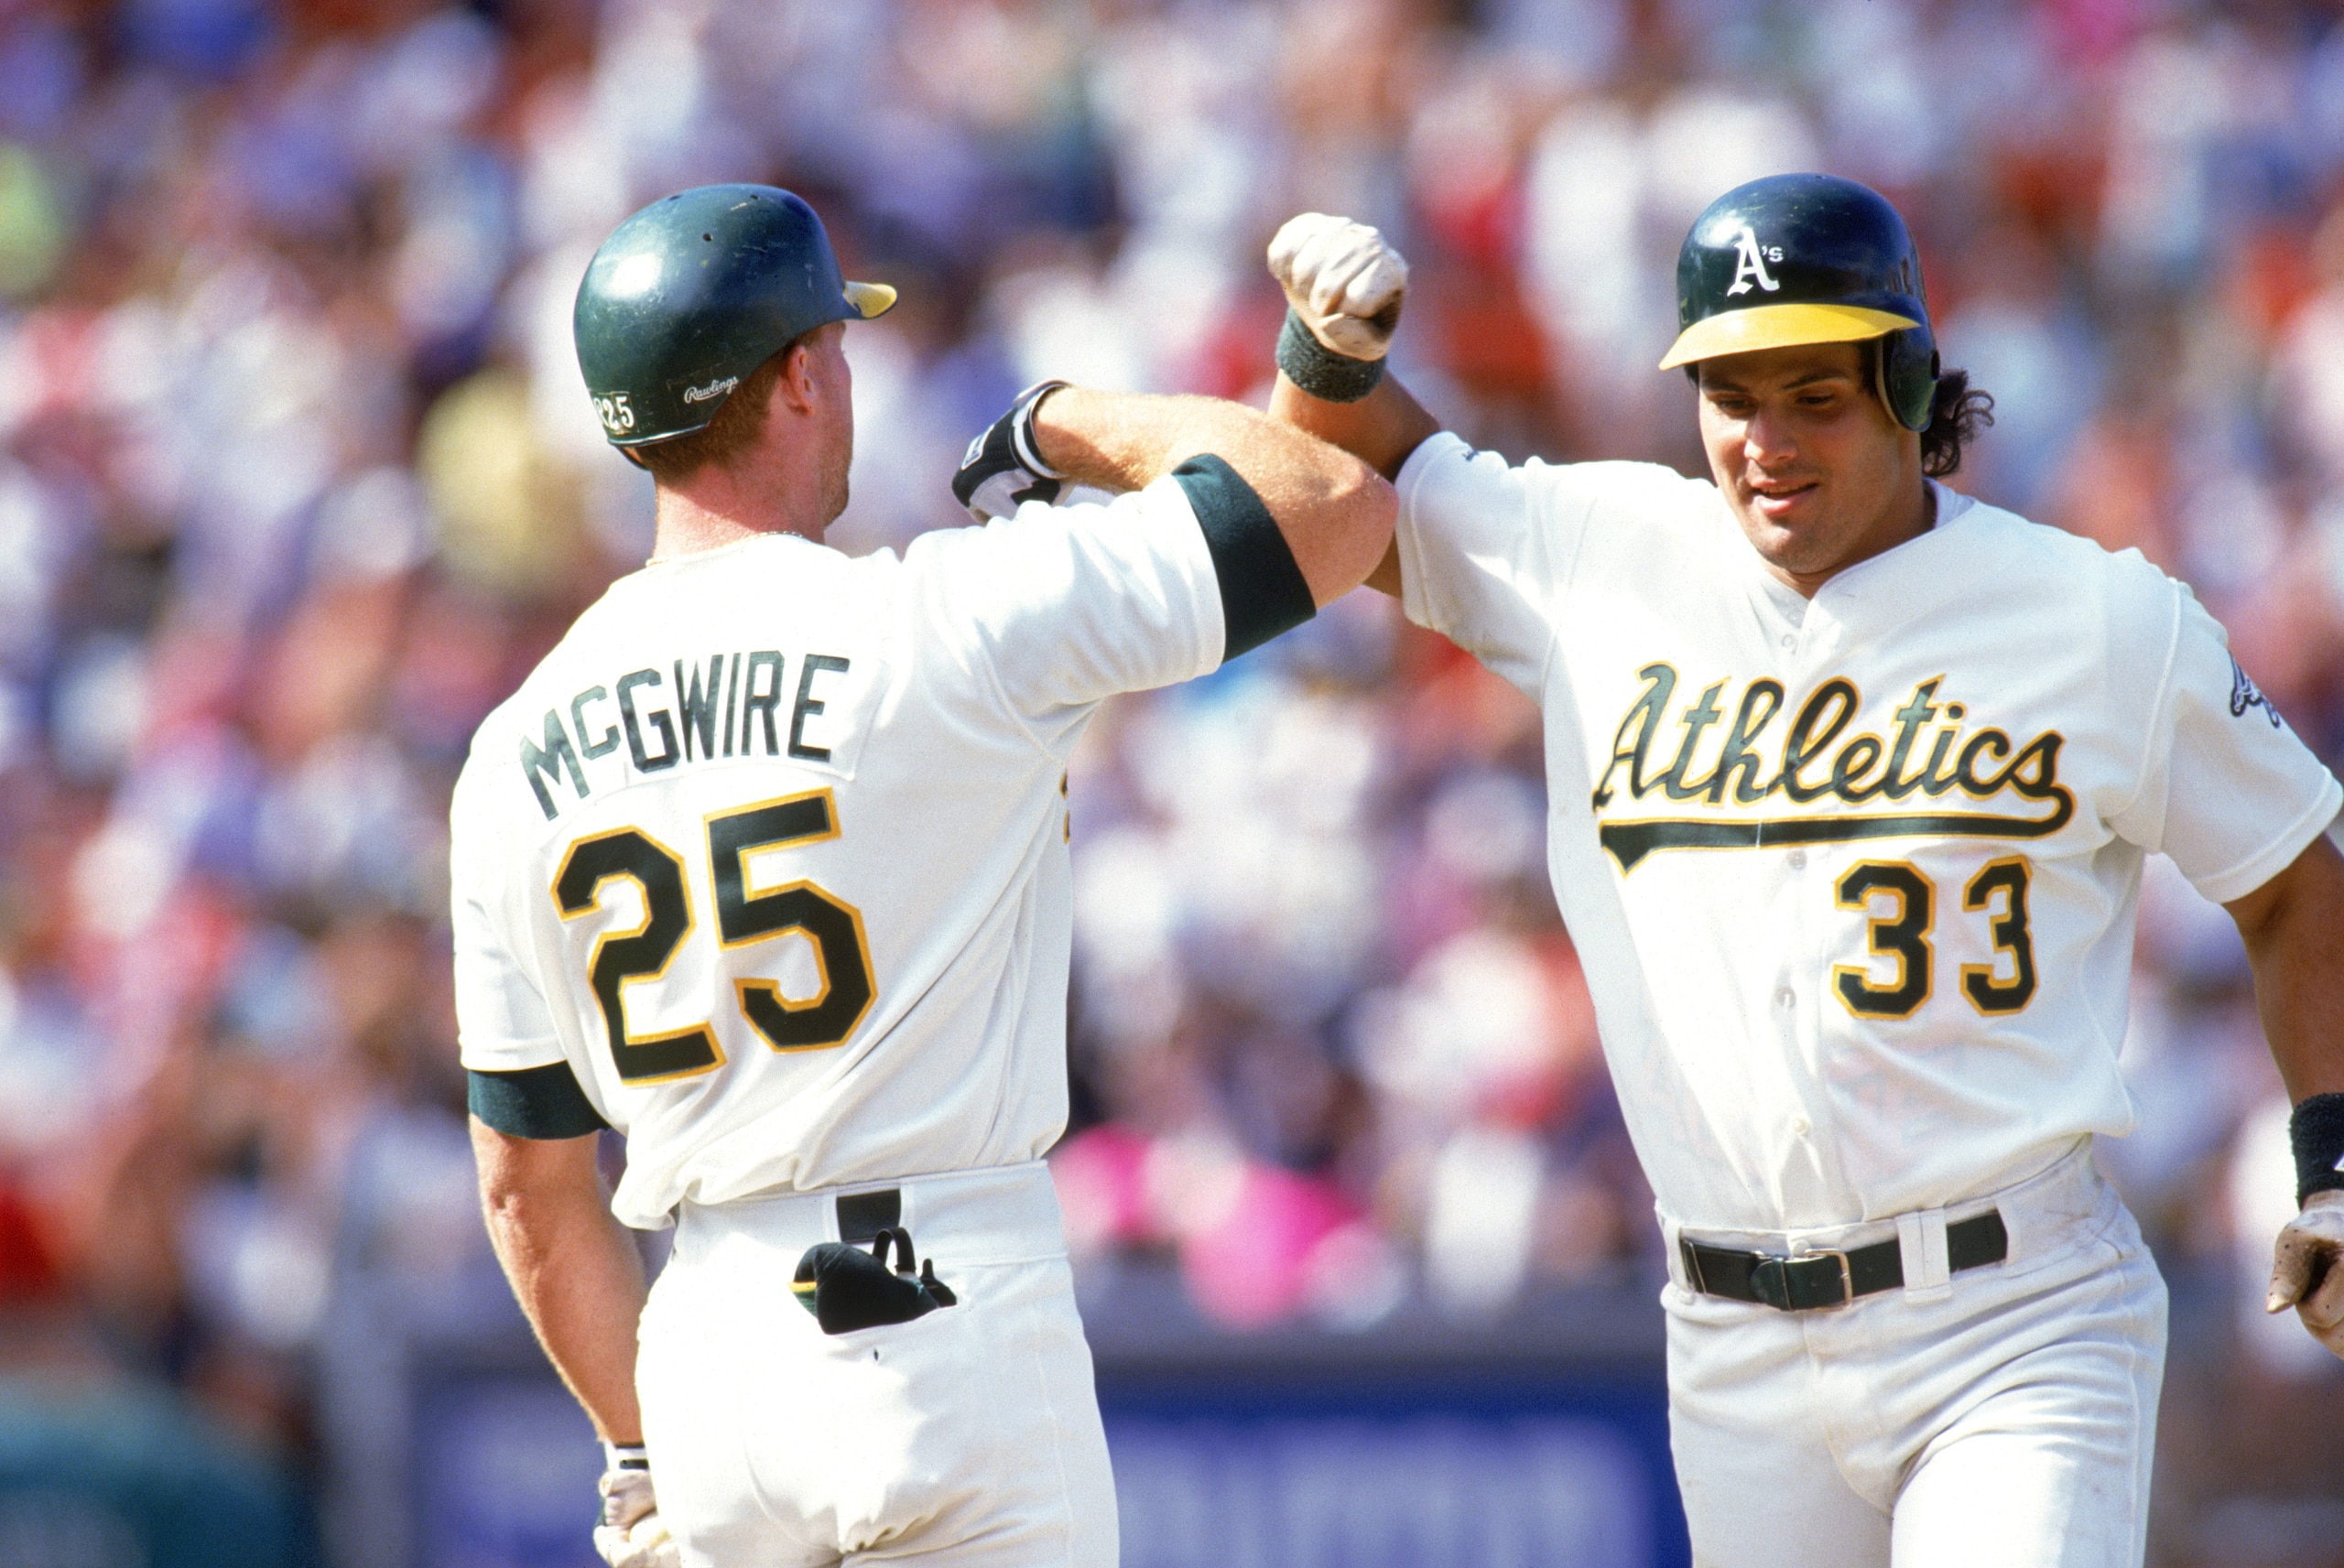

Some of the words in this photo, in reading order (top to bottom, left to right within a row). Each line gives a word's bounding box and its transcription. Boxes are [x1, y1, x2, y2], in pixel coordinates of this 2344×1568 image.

[1727, 226, 1784, 297] A's
[684, 376, 739, 404] Rawlings
[1591, 661, 2077, 844] Athletics
[550, 786, 878, 1087] 25
[1831, 853, 2039, 1021] 33
